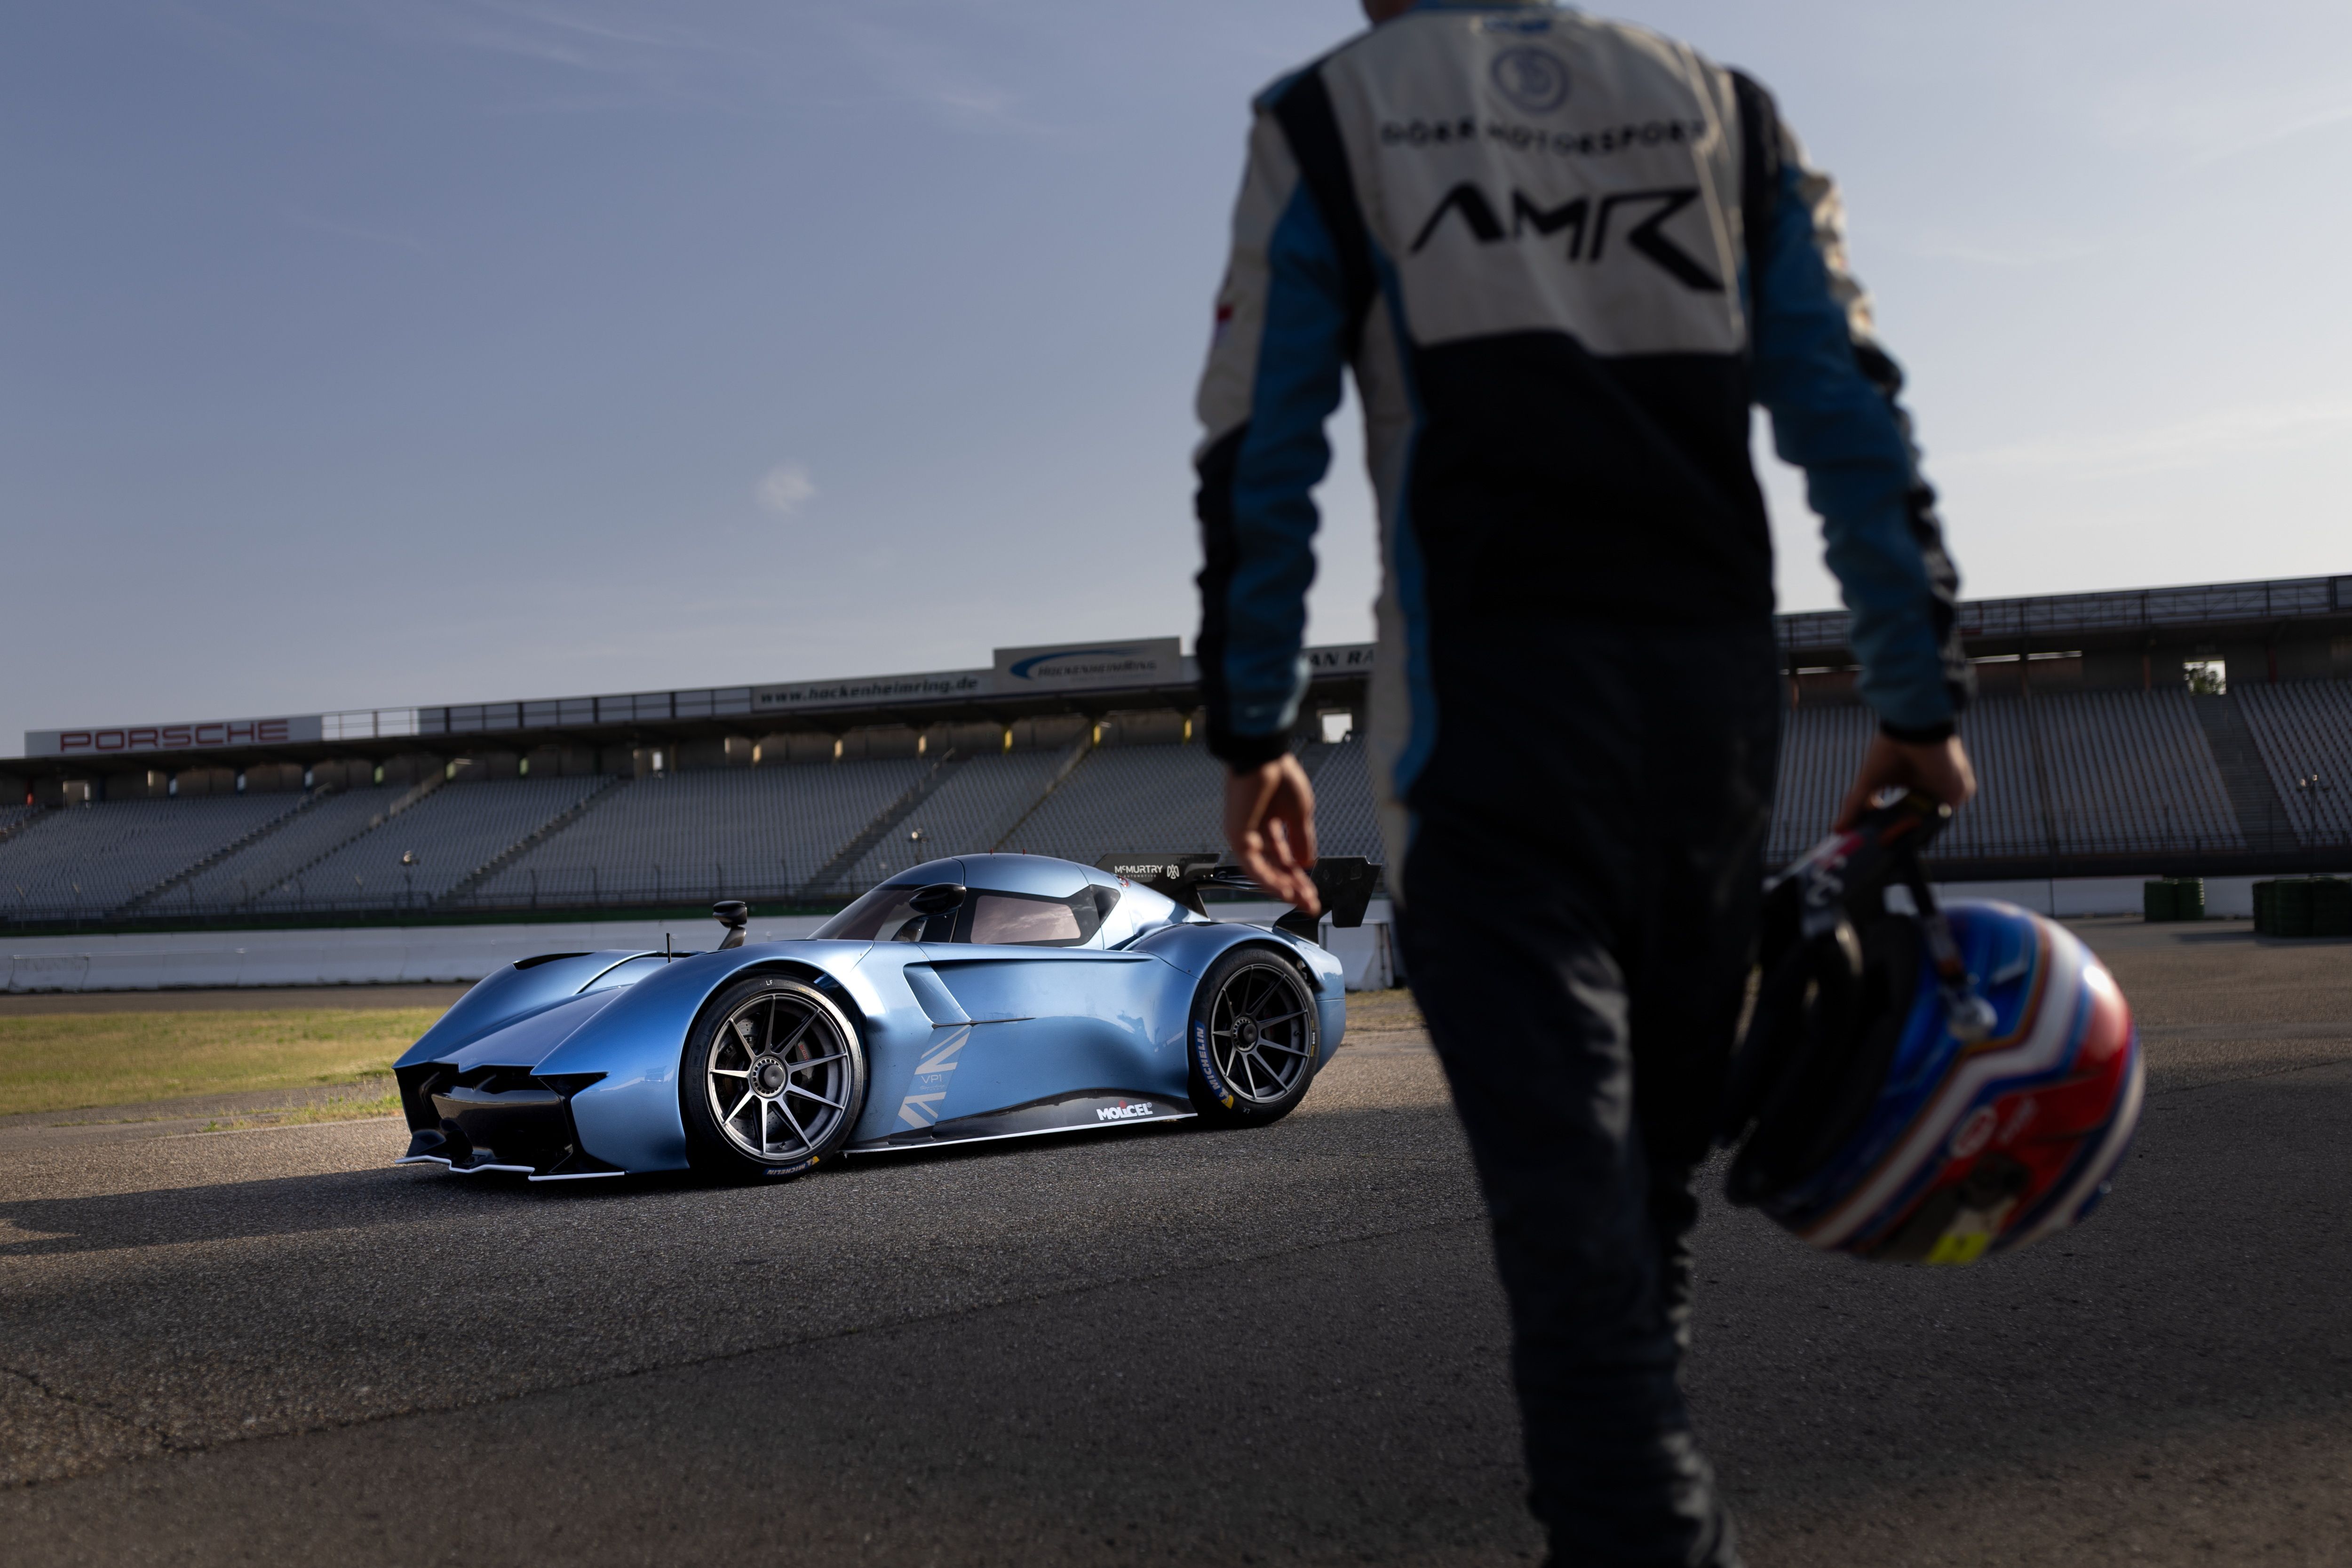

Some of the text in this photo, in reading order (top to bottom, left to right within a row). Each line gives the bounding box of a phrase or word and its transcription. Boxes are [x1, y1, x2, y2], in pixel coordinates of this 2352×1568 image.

[1409, 180, 1727, 293] AMR
[761, 677, 977, 703] www.hockenheimring.de
[60, 719, 288, 752] PORSCHE
[1196, 1027, 1221, 1090] MICHELIN
[921, 1074, 942, 1083] VP1
[766, 1163, 806, 1175] MICHELIN
